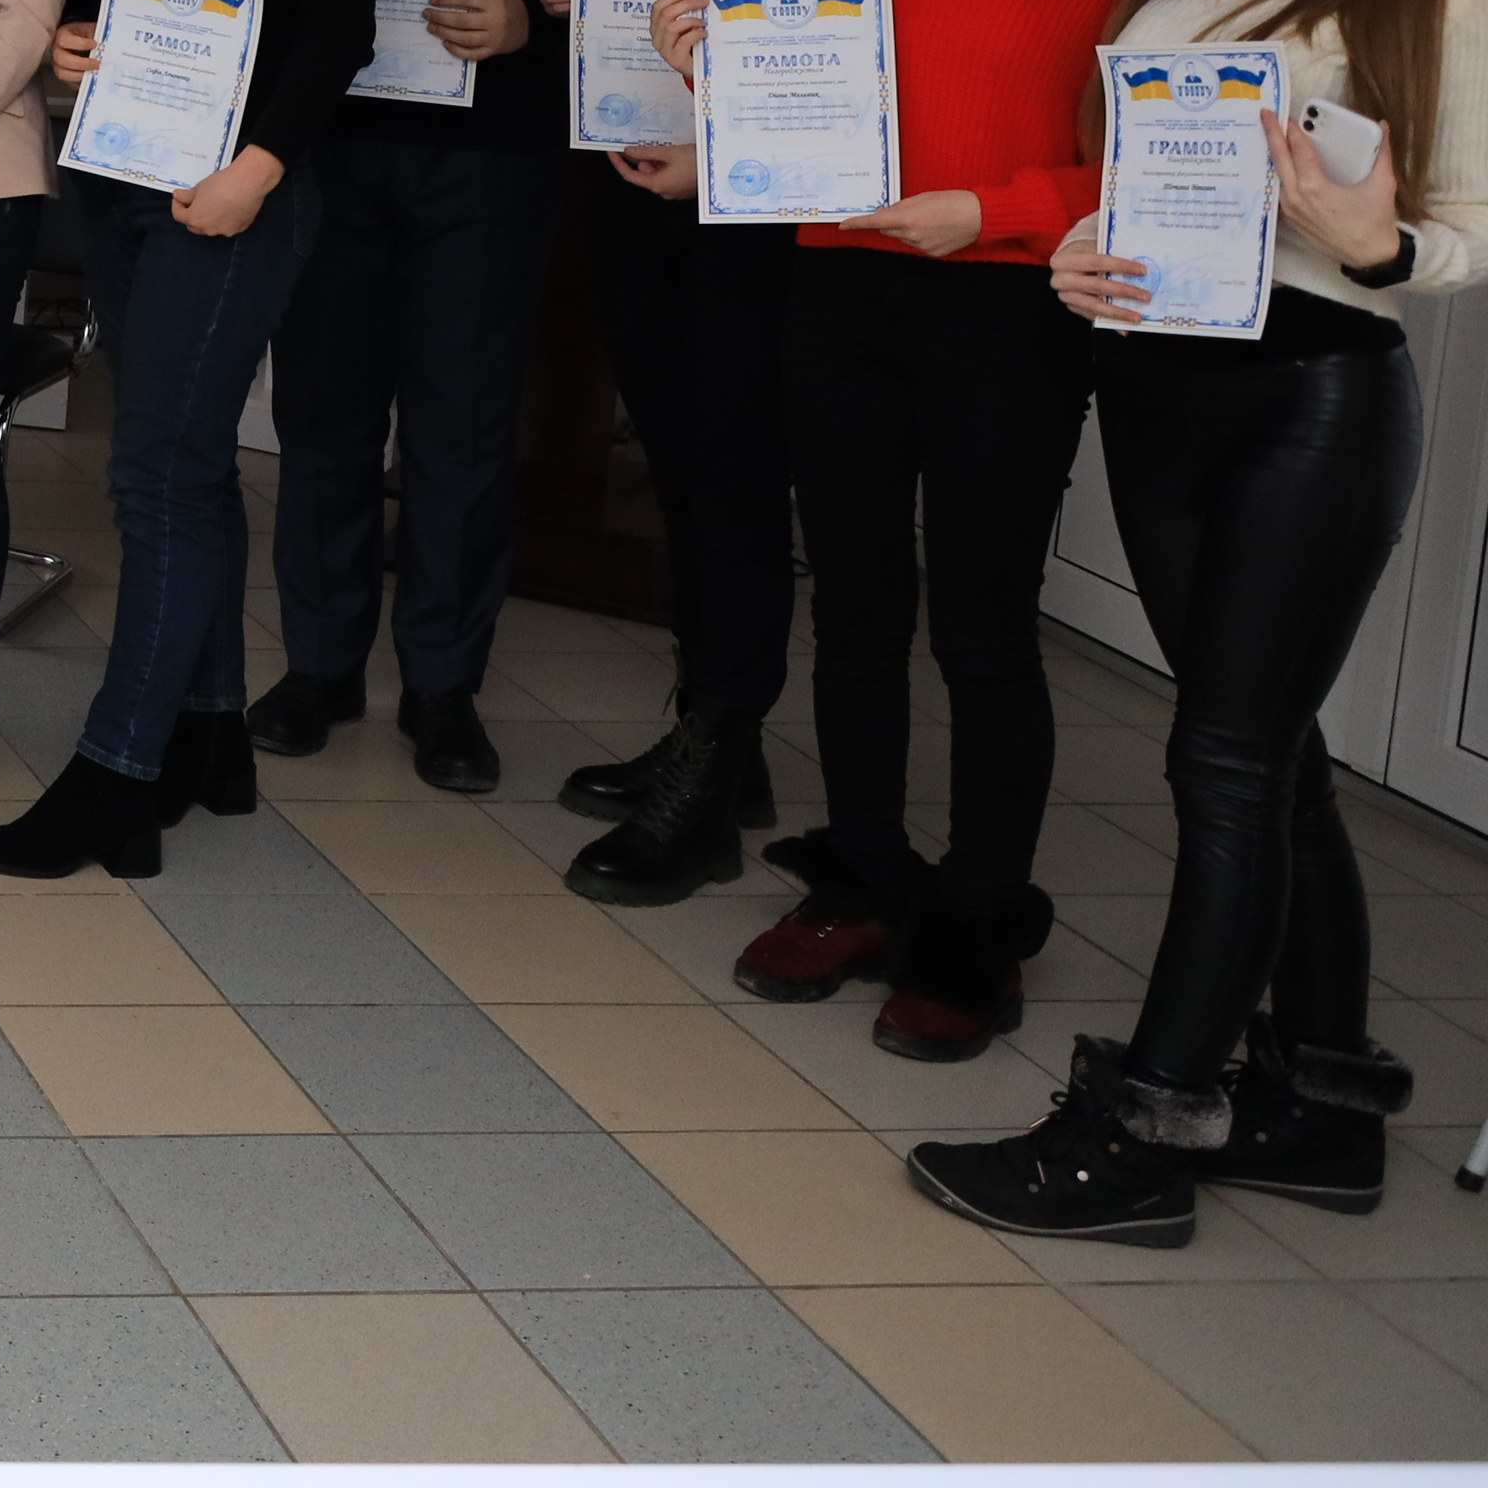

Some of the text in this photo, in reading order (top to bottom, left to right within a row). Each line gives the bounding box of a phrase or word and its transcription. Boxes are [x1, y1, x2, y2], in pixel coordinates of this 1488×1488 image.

[769, 5, 811, 18] ТНПУ
[135, 30, 211, 57] ГРАМОТА
[742, 53, 841, 68] ГРАМОТА
[1175, 86, 1213, 99] ТНПУ
[1148, 140, 1237, 156] ГРАМОТА
